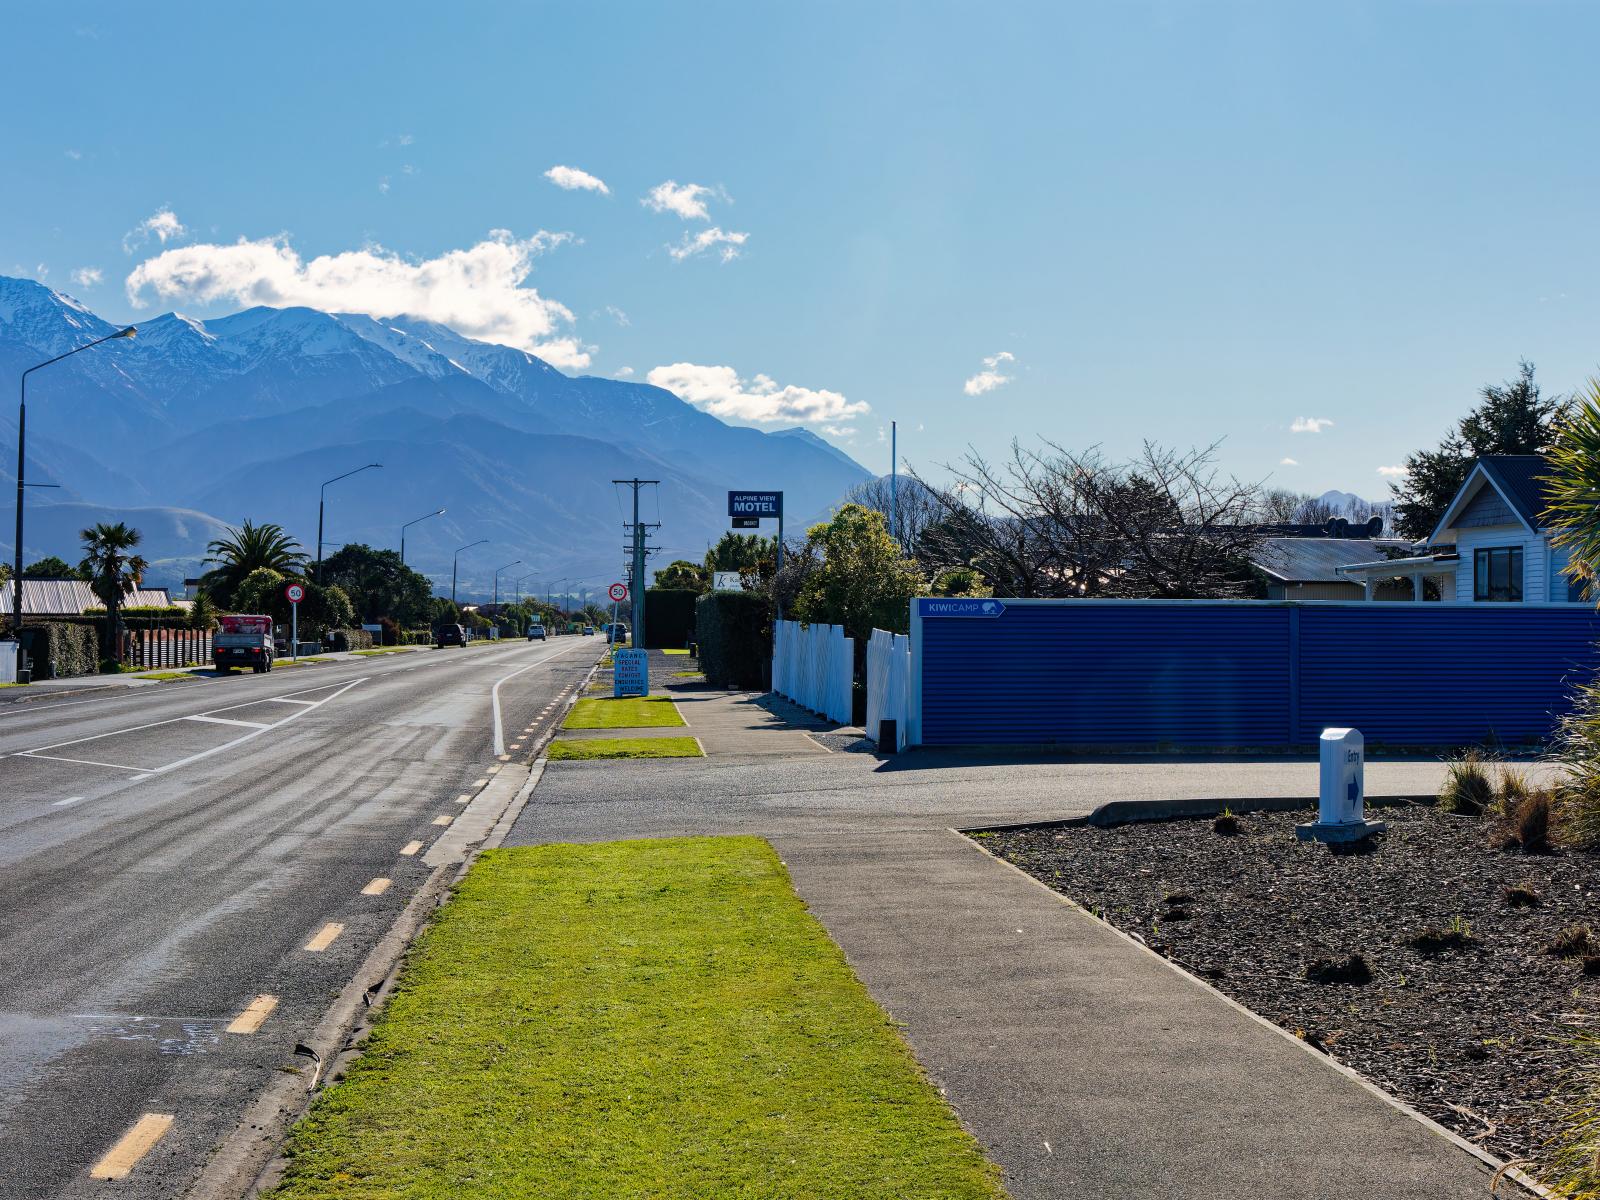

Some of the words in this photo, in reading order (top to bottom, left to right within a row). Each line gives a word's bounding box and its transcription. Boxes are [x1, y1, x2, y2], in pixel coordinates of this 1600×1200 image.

[734, 502, 776, 512] MOTEL
[613, 588, 624, 596] 50
[928, 603, 979, 612] KIWICAMP
[1347, 749, 1360, 765] Entry
